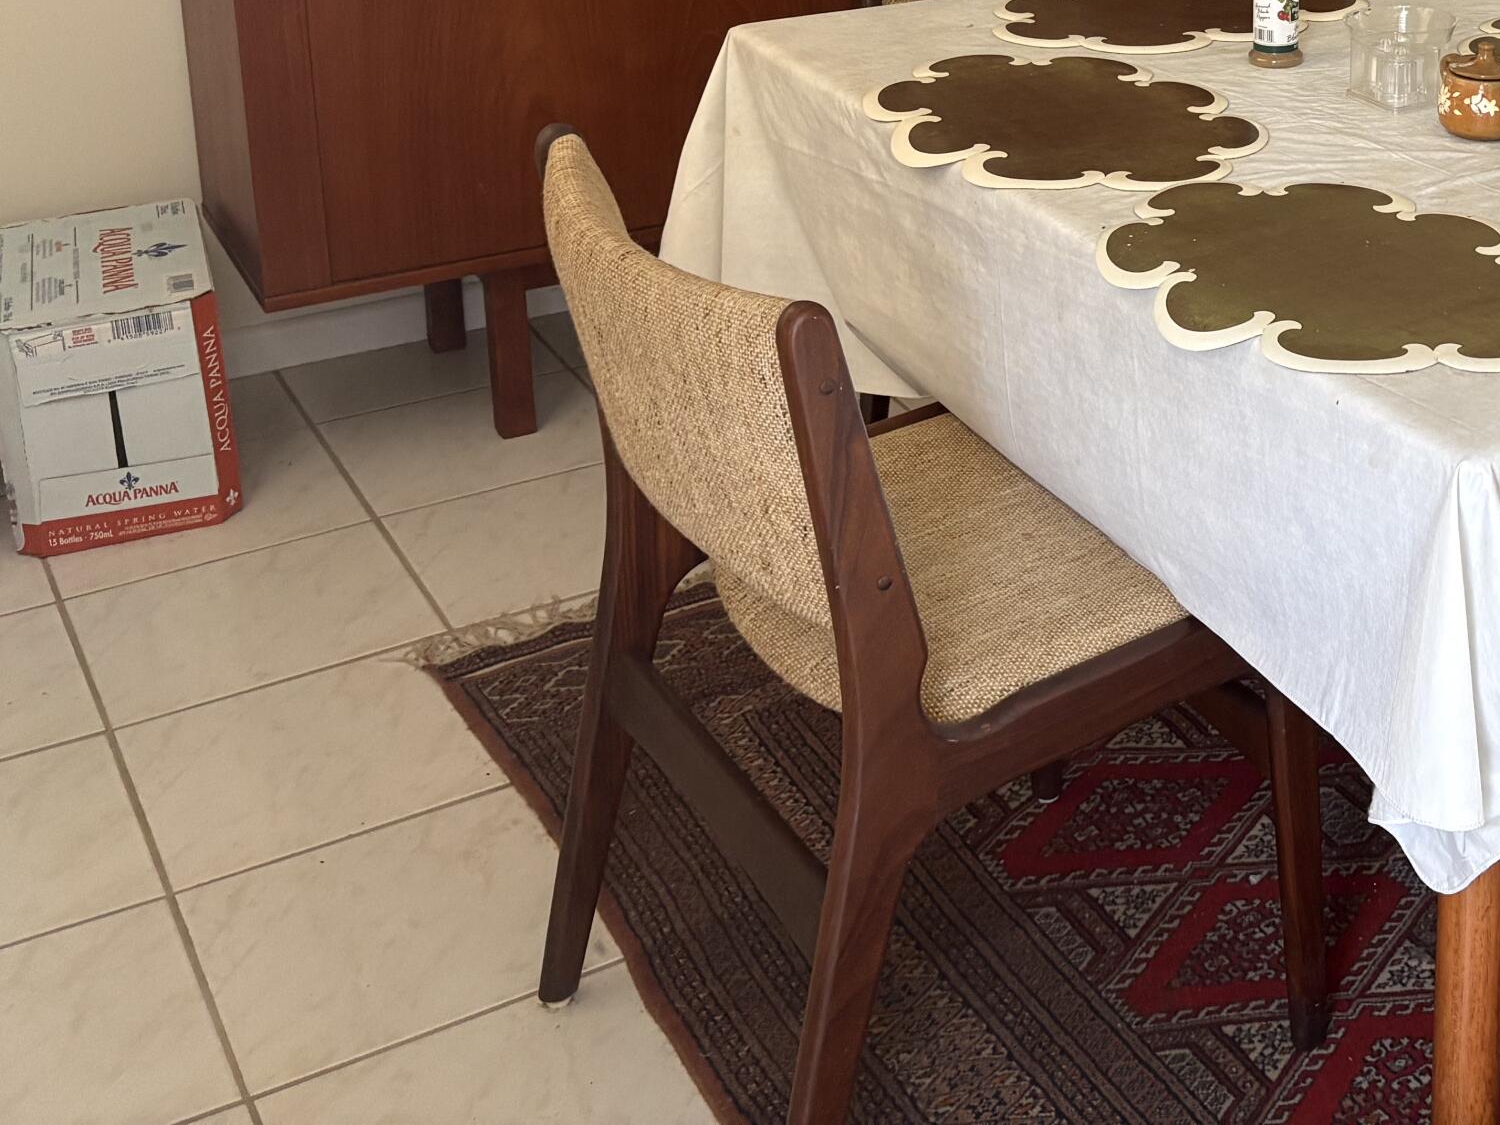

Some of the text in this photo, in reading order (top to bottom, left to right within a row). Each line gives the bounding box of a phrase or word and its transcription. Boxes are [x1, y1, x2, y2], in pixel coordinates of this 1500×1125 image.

[92, 227, 133, 260] ACQUA
[101, 257, 138, 294] PANNA
[203, 325, 232, 452] ACQUA PANNA
[85, 481, 179, 508] ACQUA PANNA
[48, 521, 108, 537] NATURAL
[117, 513, 166, 526] SPRING
[173, 504, 217, 517] WATER
[48, 538, 58, 547] 15
[89, 530, 113, 541] 750mL
